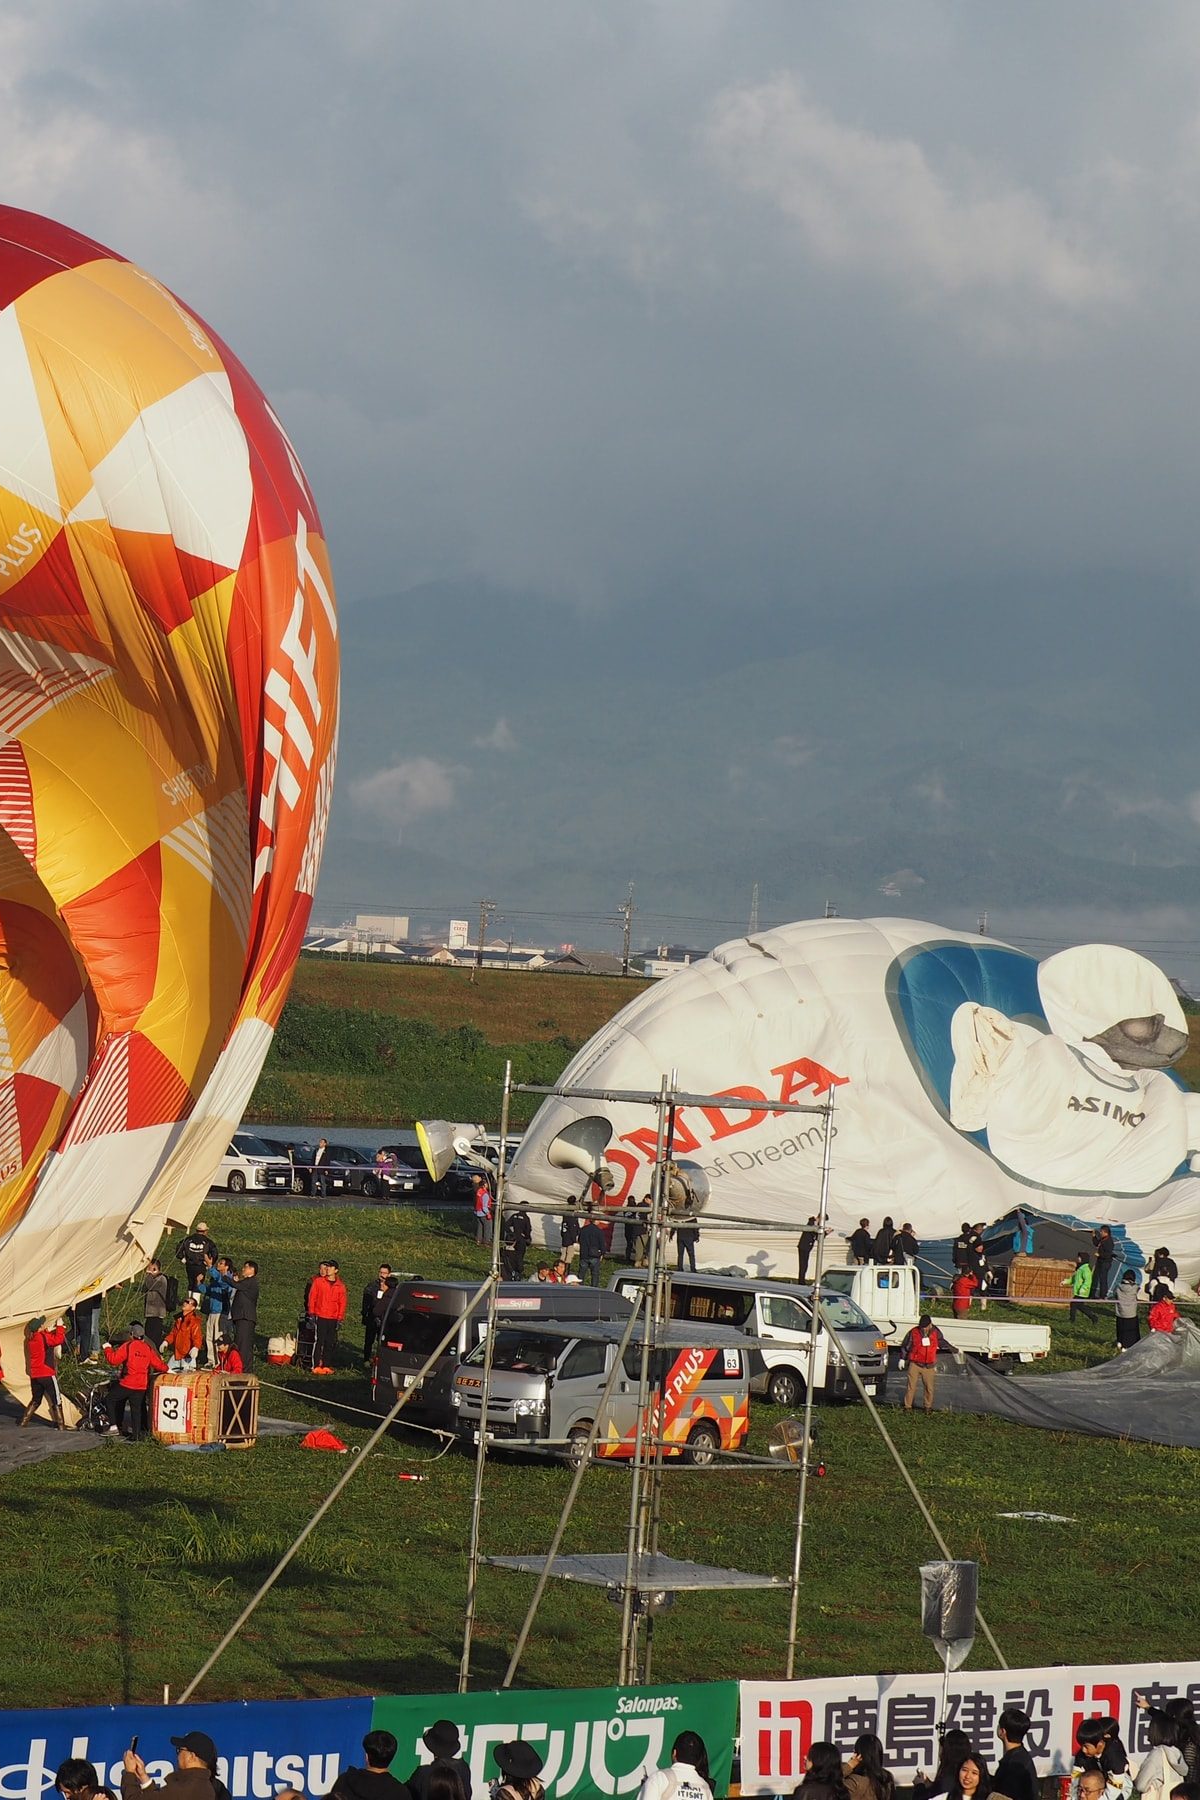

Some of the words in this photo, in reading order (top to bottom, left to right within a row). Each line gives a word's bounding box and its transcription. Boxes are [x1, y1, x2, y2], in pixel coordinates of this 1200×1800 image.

[1067, 1095, 1146, 1128] ASIMO
[584, 1056, 850, 1252] ONDA
[728, 1121, 839, 1172] Dreams
[672, 1348, 705, 1395] PLUS
[726, 1358, 737, 1369] 63
[163, 1397, 179, 1420] 63
[615, 1695, 680, 1714] Salonpas
